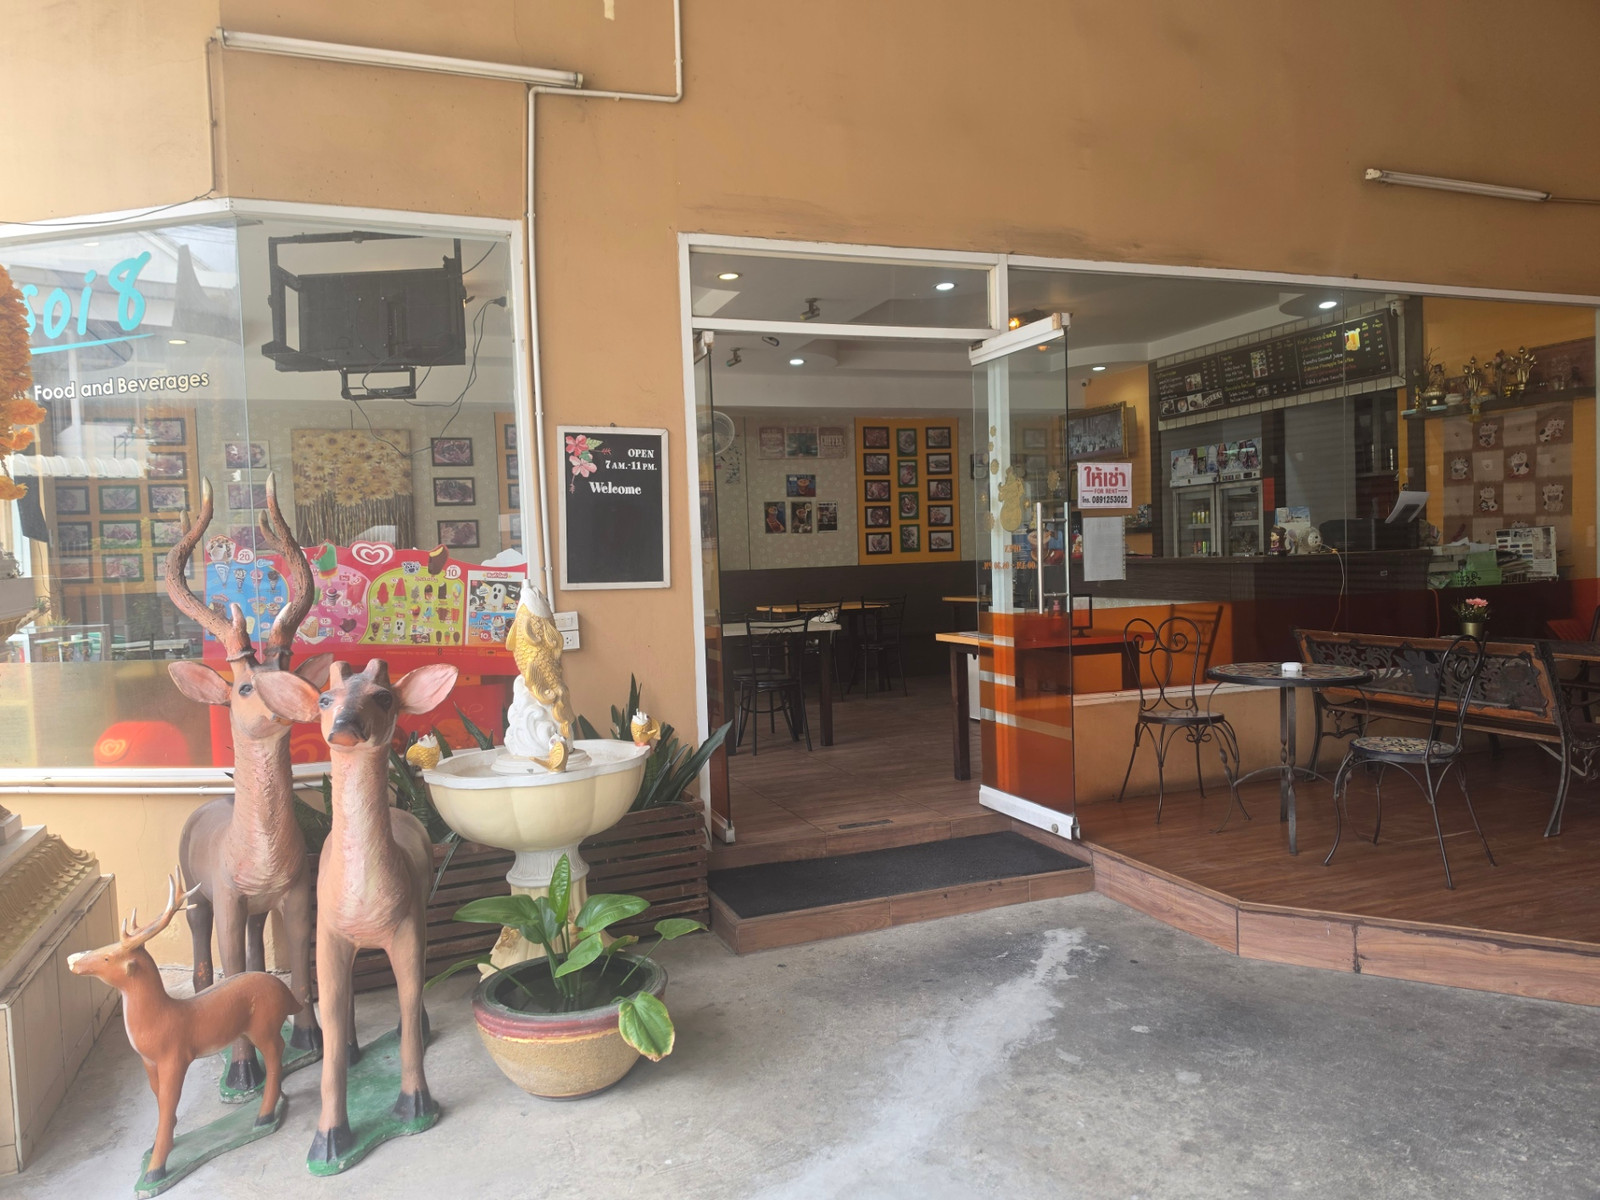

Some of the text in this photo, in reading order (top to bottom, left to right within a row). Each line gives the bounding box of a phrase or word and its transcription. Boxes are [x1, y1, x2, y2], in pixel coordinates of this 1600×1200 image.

[108, 251, 152, 331] 8
[34, 372, 210, 401] Food and Beverages
[628, 448, 655, 458] OPEN
[1084, 466, 1127, 487] ให้เช่า
[589, 481, 642, 495] Welcome
[1092, 495, 1128, 504] 0891253022
[447, 568, 457, 577] 10
